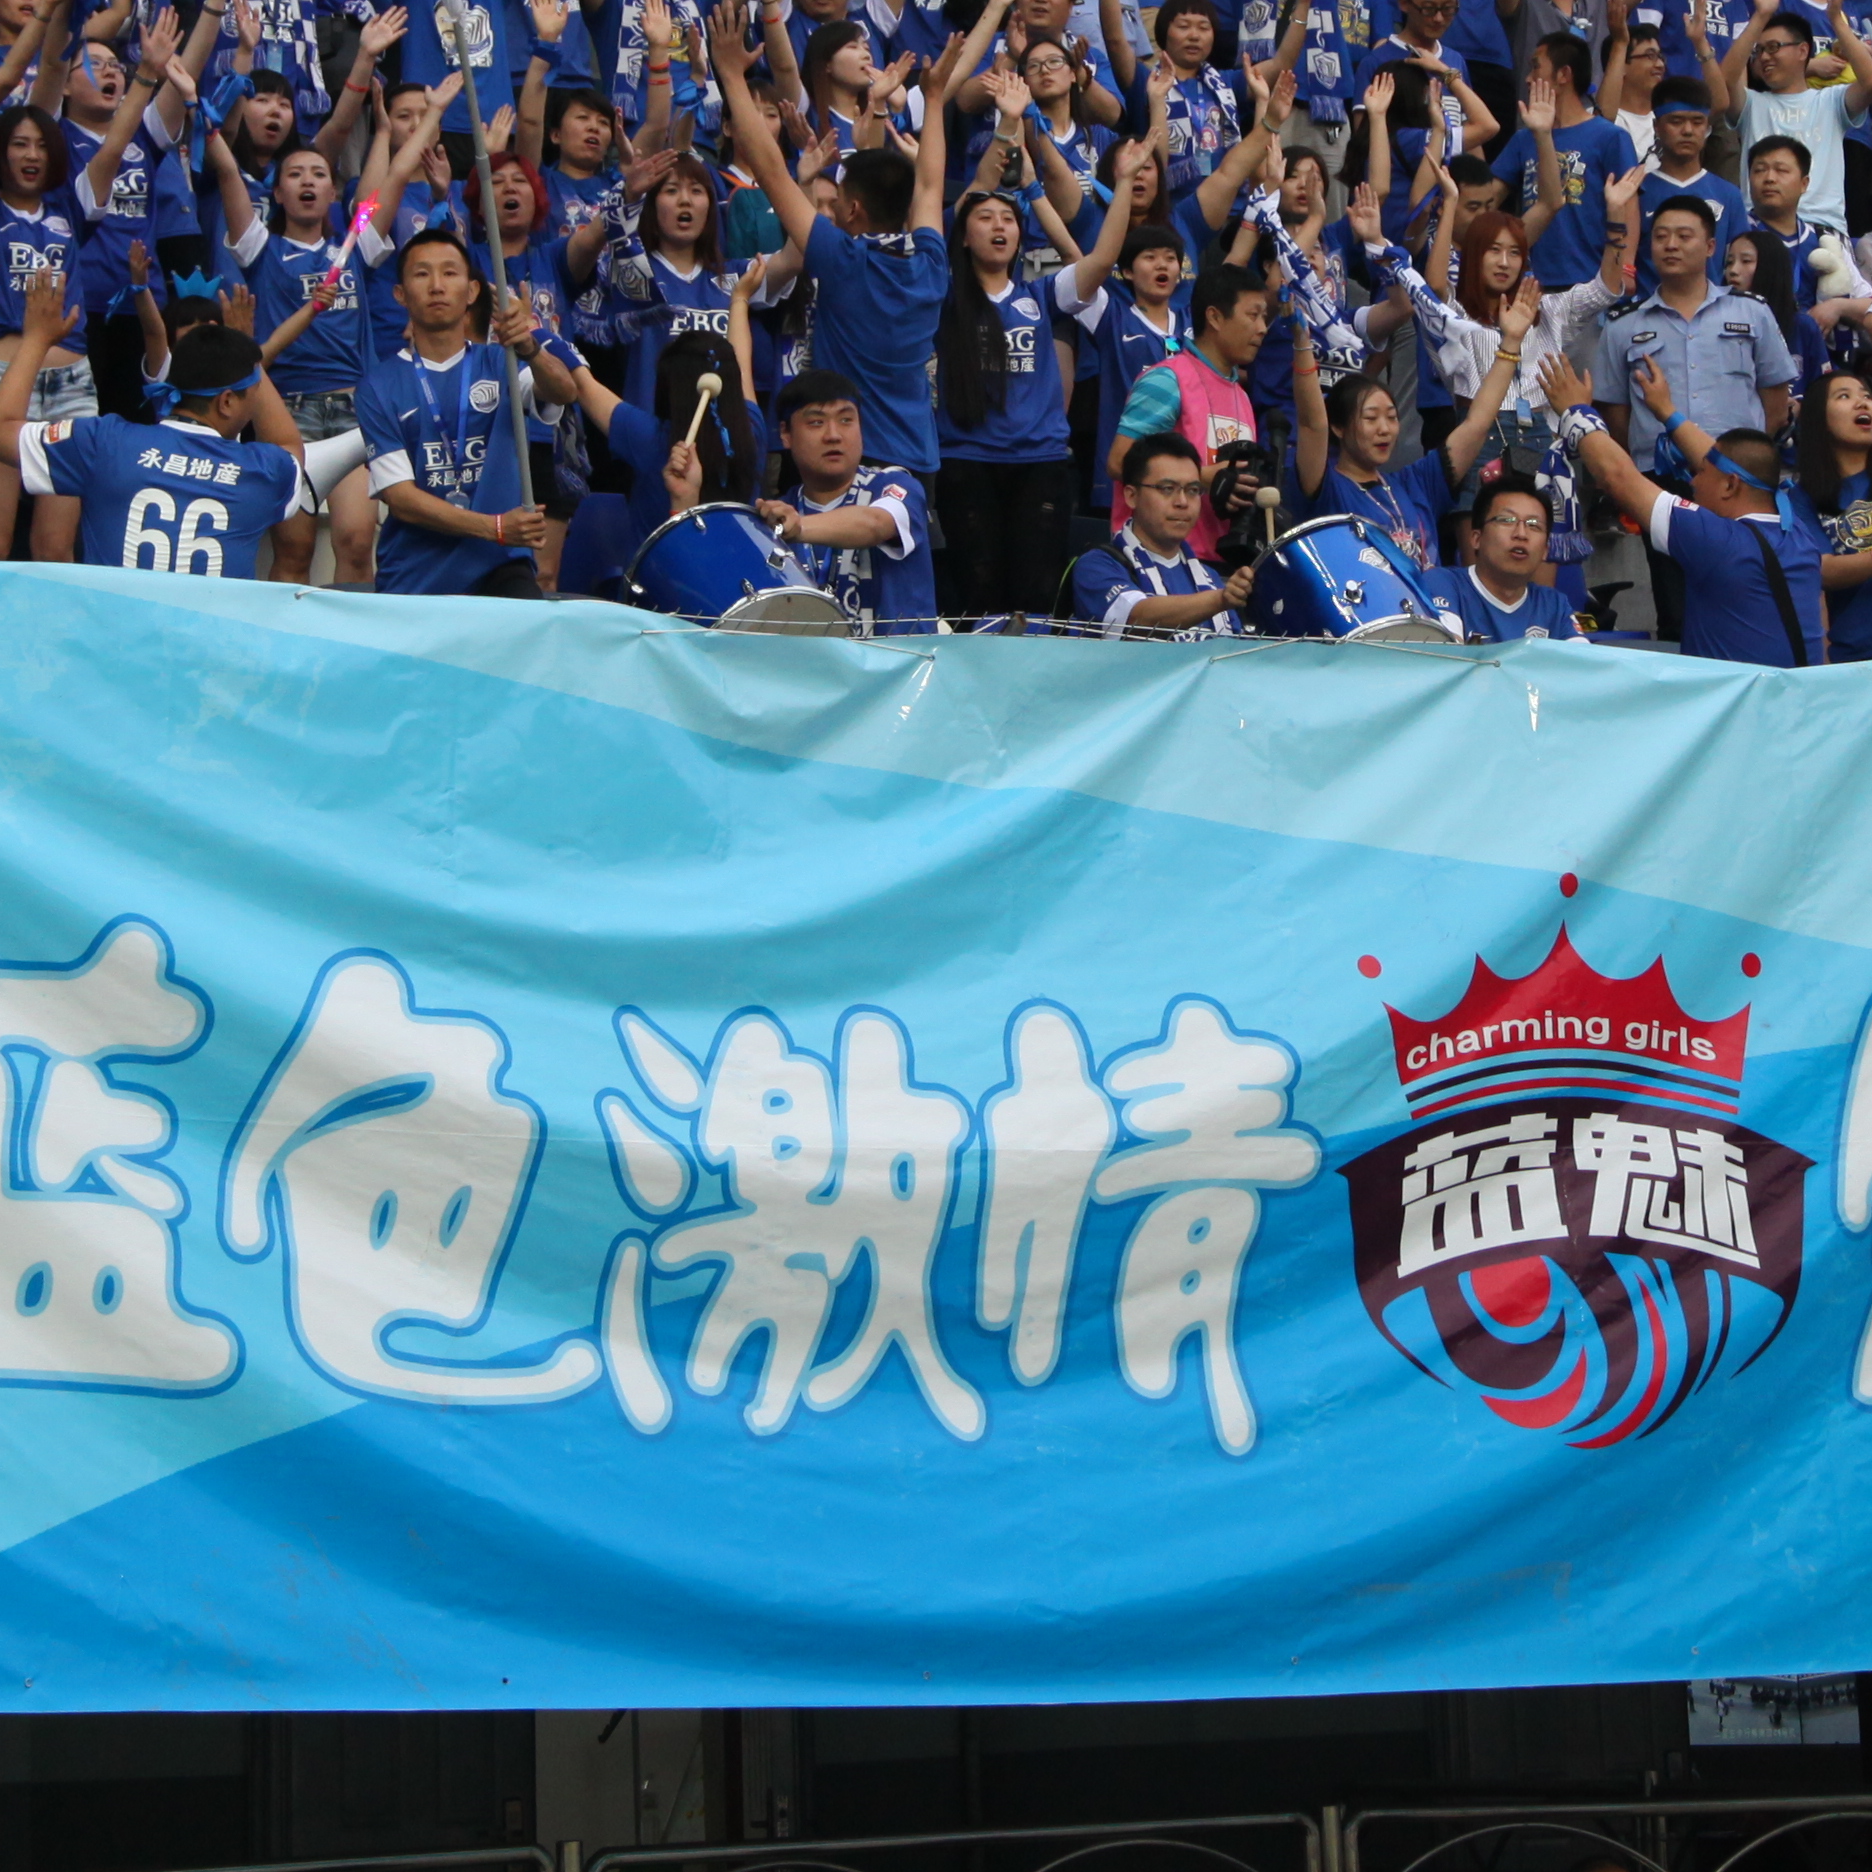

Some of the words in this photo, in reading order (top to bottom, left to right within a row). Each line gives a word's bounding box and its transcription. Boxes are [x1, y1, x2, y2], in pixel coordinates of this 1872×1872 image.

[113, 171, 147, 198] BG
[9, 245, 64, 270] EBG
[301, 272, 356, 294] EG
[671, 310, 729, 335] EBG
[1004, 329, 1035, 352] BG
[1312, 341, 1364, 371] EBG
[123, 487, 229, 577] 66
[1405, 1010, 1610, 1071] charming
[1624, 1020, 1716, 1061] girls
[1397, 1112, 1760, 1278] 蓝魅
